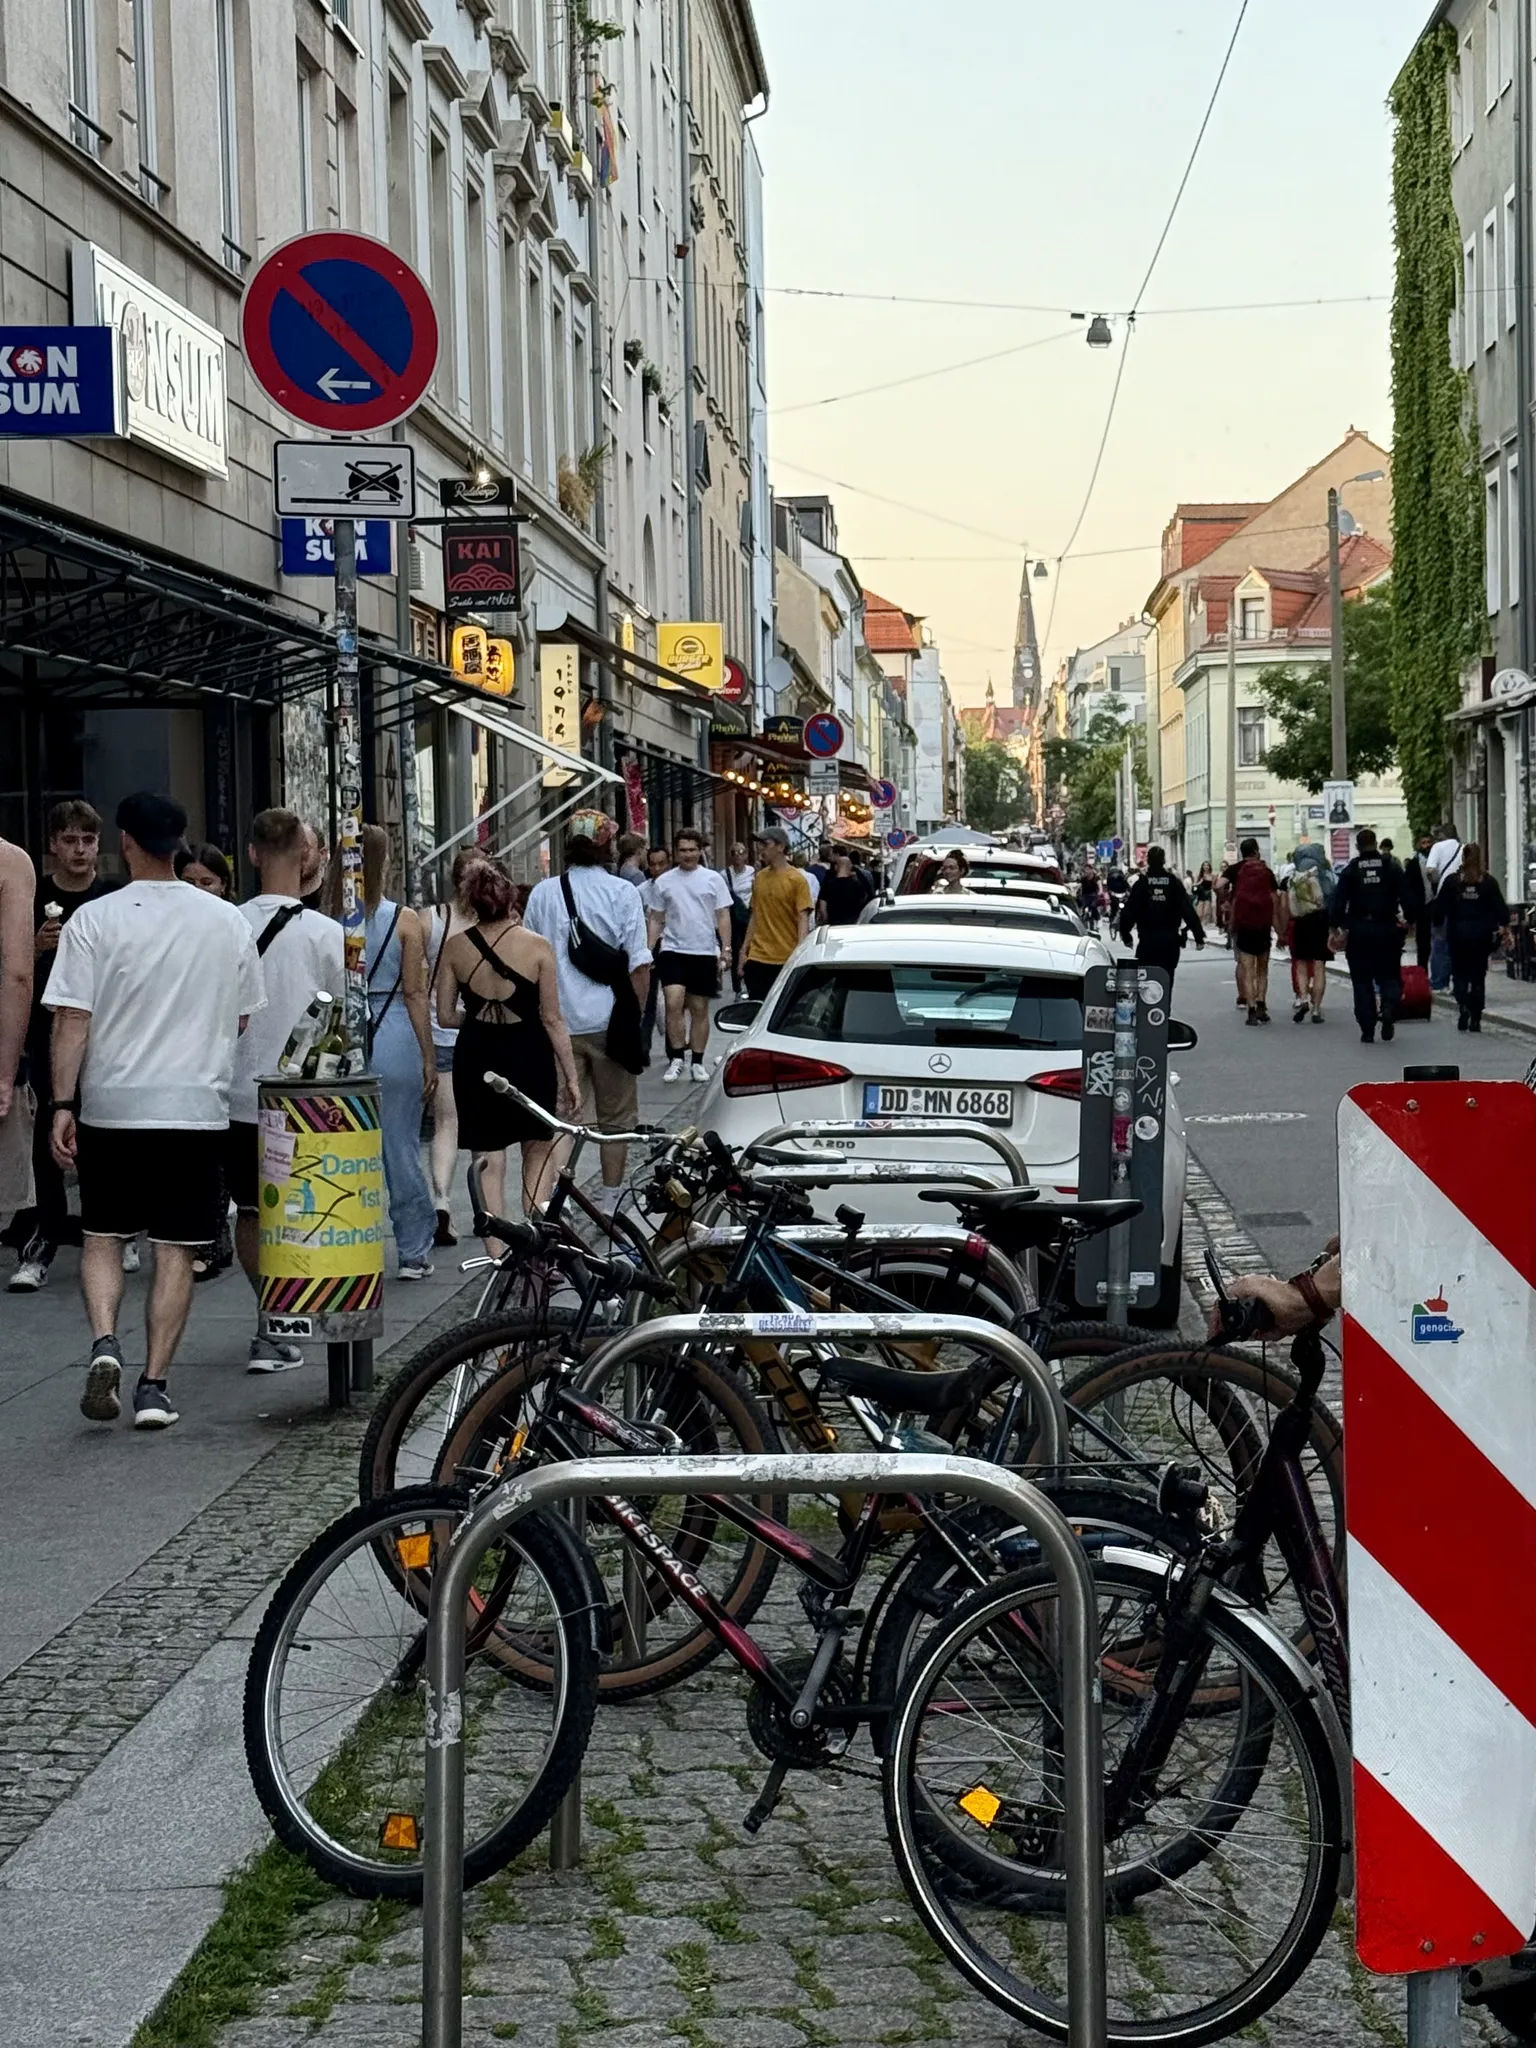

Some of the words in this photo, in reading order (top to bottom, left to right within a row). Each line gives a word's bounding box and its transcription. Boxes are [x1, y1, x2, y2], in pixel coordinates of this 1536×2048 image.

[457, 541, 501, 559] KAI
[880, 1089, 908, 1112] DD
[924, 1090, 952, 1114] MN
[957, 1092, 1009, 1115] 6868
[811, 1139, 824, 1149] A
[825, 1139, 856, 1150] 200
[1420, 1324, 1461, 1335] genoc
